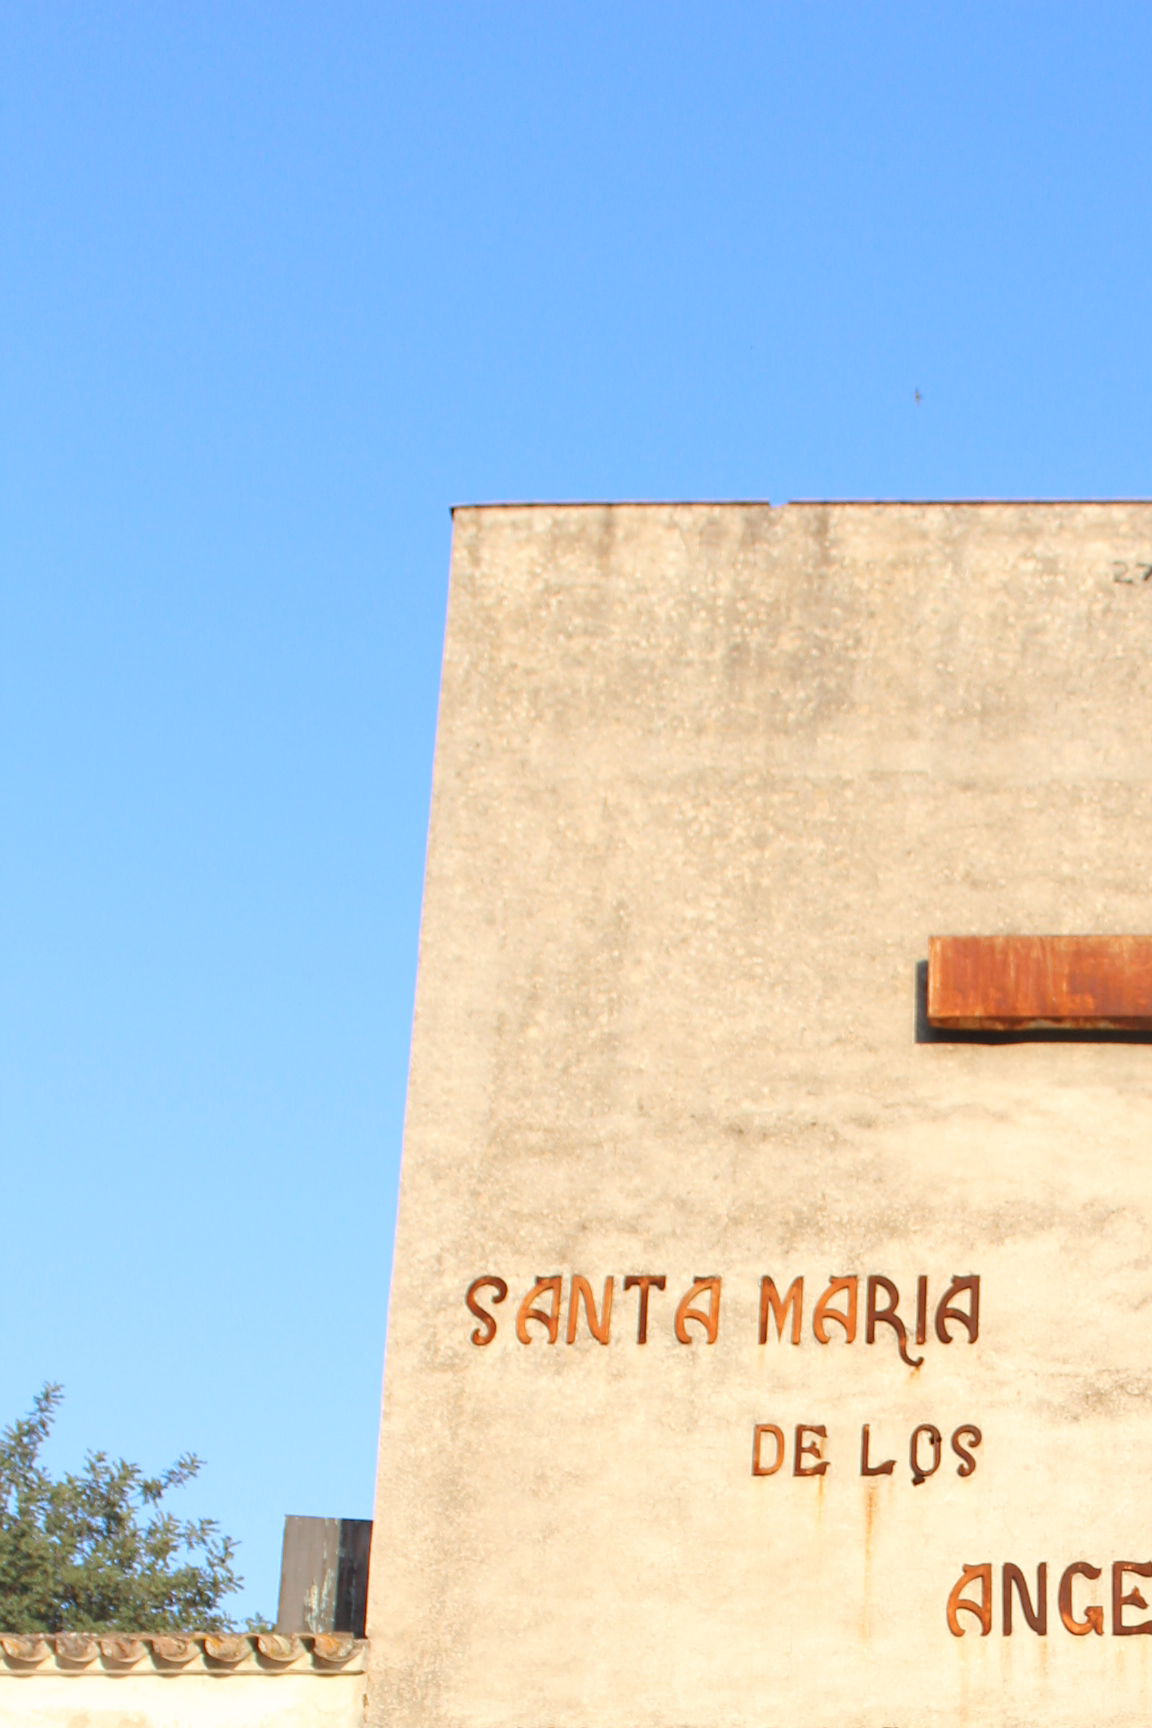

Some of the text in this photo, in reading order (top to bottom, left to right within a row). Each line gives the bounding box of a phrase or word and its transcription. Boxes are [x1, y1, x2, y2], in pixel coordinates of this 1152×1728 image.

[464, 1274, 981, 1367] SANTA MARIA
[751, 1423, 983, 1487] DE LOS
